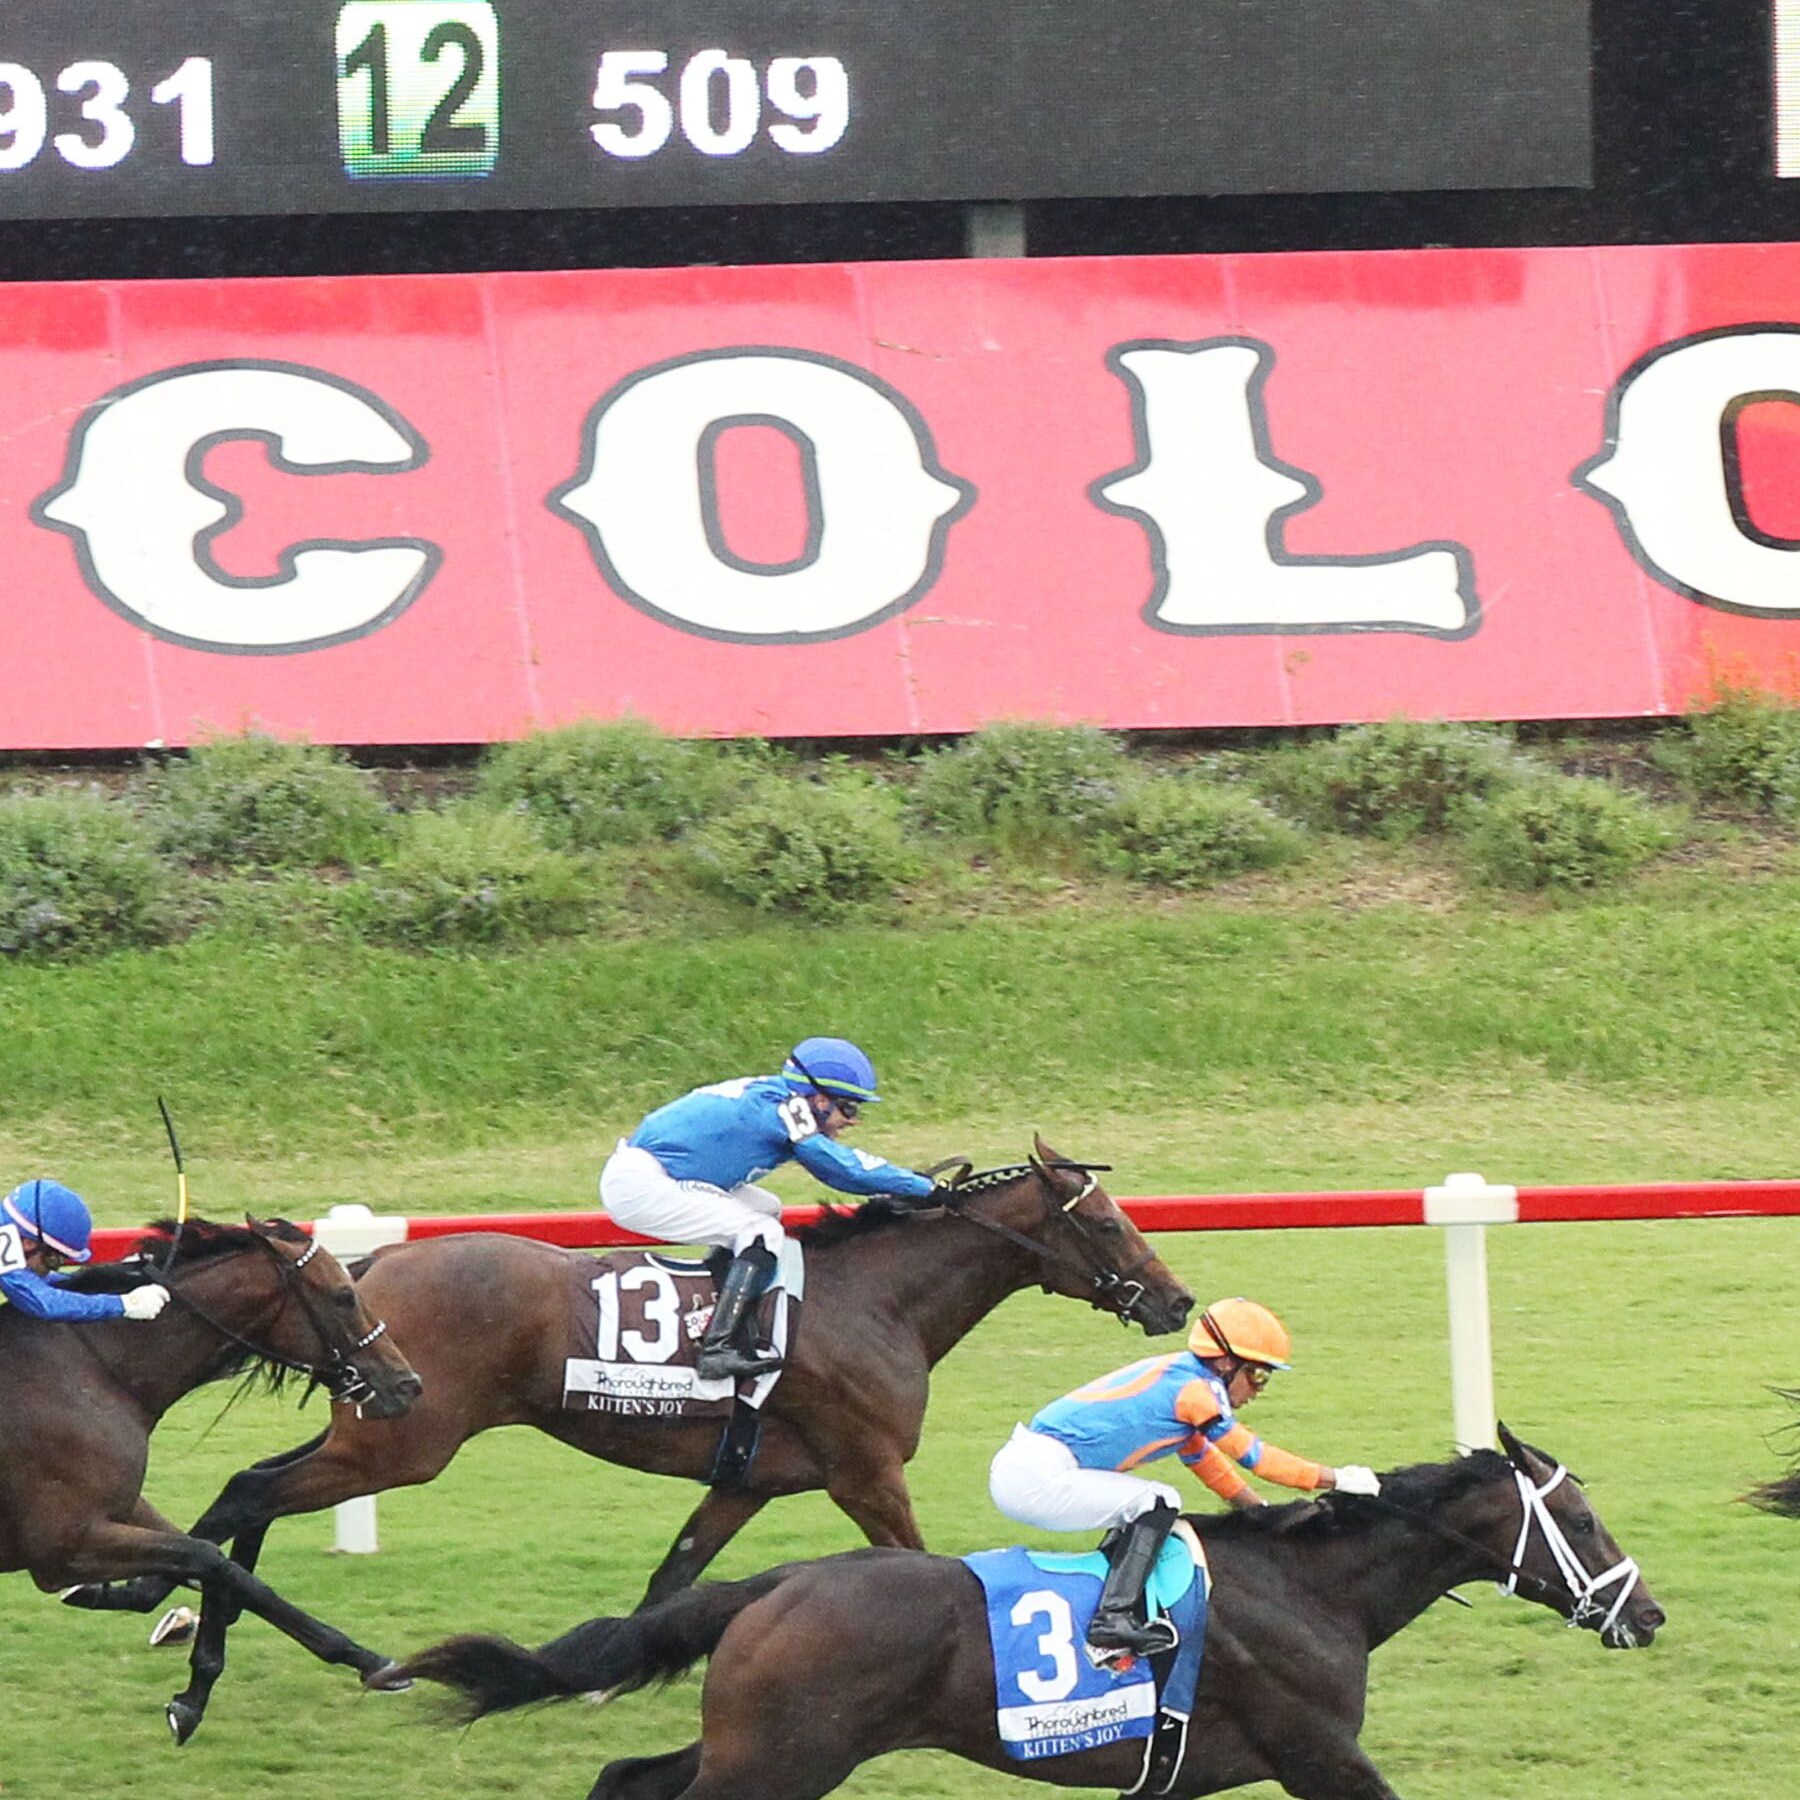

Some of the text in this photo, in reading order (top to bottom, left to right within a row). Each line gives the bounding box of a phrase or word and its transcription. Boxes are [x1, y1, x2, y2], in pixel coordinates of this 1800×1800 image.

[344, 21, 486, 155] 12
[589, 49, 851, 157] 509
[777, 1097, 818, 1142] 13
[591, 1265, 681, 1364] 13
[593, 1370, 693, 1393] Thoroughbred
[587, 1394, 687, 1416] KITTEN'S JOY
[1009, 1589, 1079, 1703] 3
[1024, 1701, 1128, 1731] Thoroughbred
[1023, 1731, 1094, 1758] KITTEN'S
[1095, 1723, 1125, 1746] JOY
